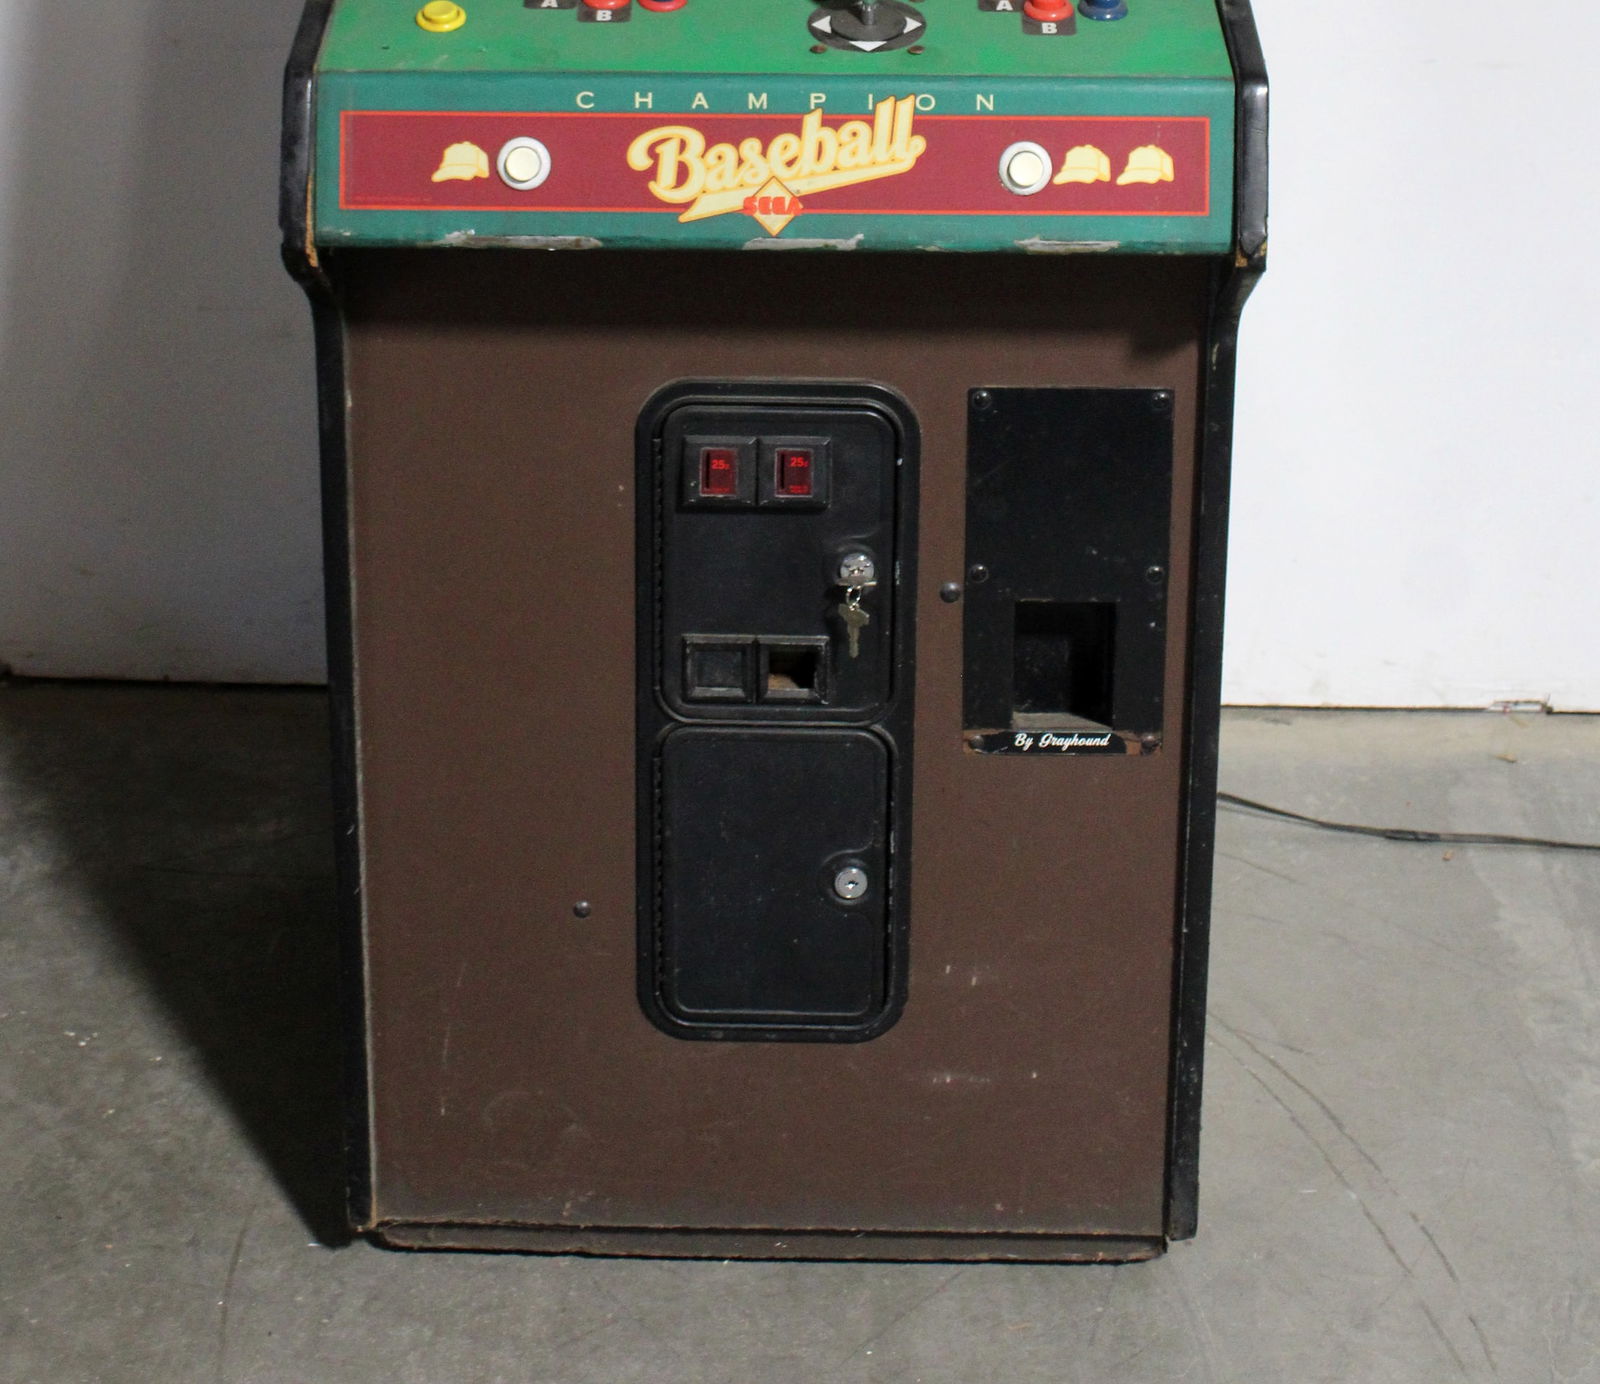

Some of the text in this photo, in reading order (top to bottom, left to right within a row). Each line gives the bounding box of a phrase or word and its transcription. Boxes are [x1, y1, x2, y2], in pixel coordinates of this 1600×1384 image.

[596, 9, 612, 21] B
[996, 0, 1013, 11] A
[1041, 22, 1058, 34] B
[575, 91, 995, 111] CHAMPION
[626, 94, 927, 211] Baseball
[743, 196, 803, 216] SEGA
[1014, 732, 1112, 751] By Grayhound
